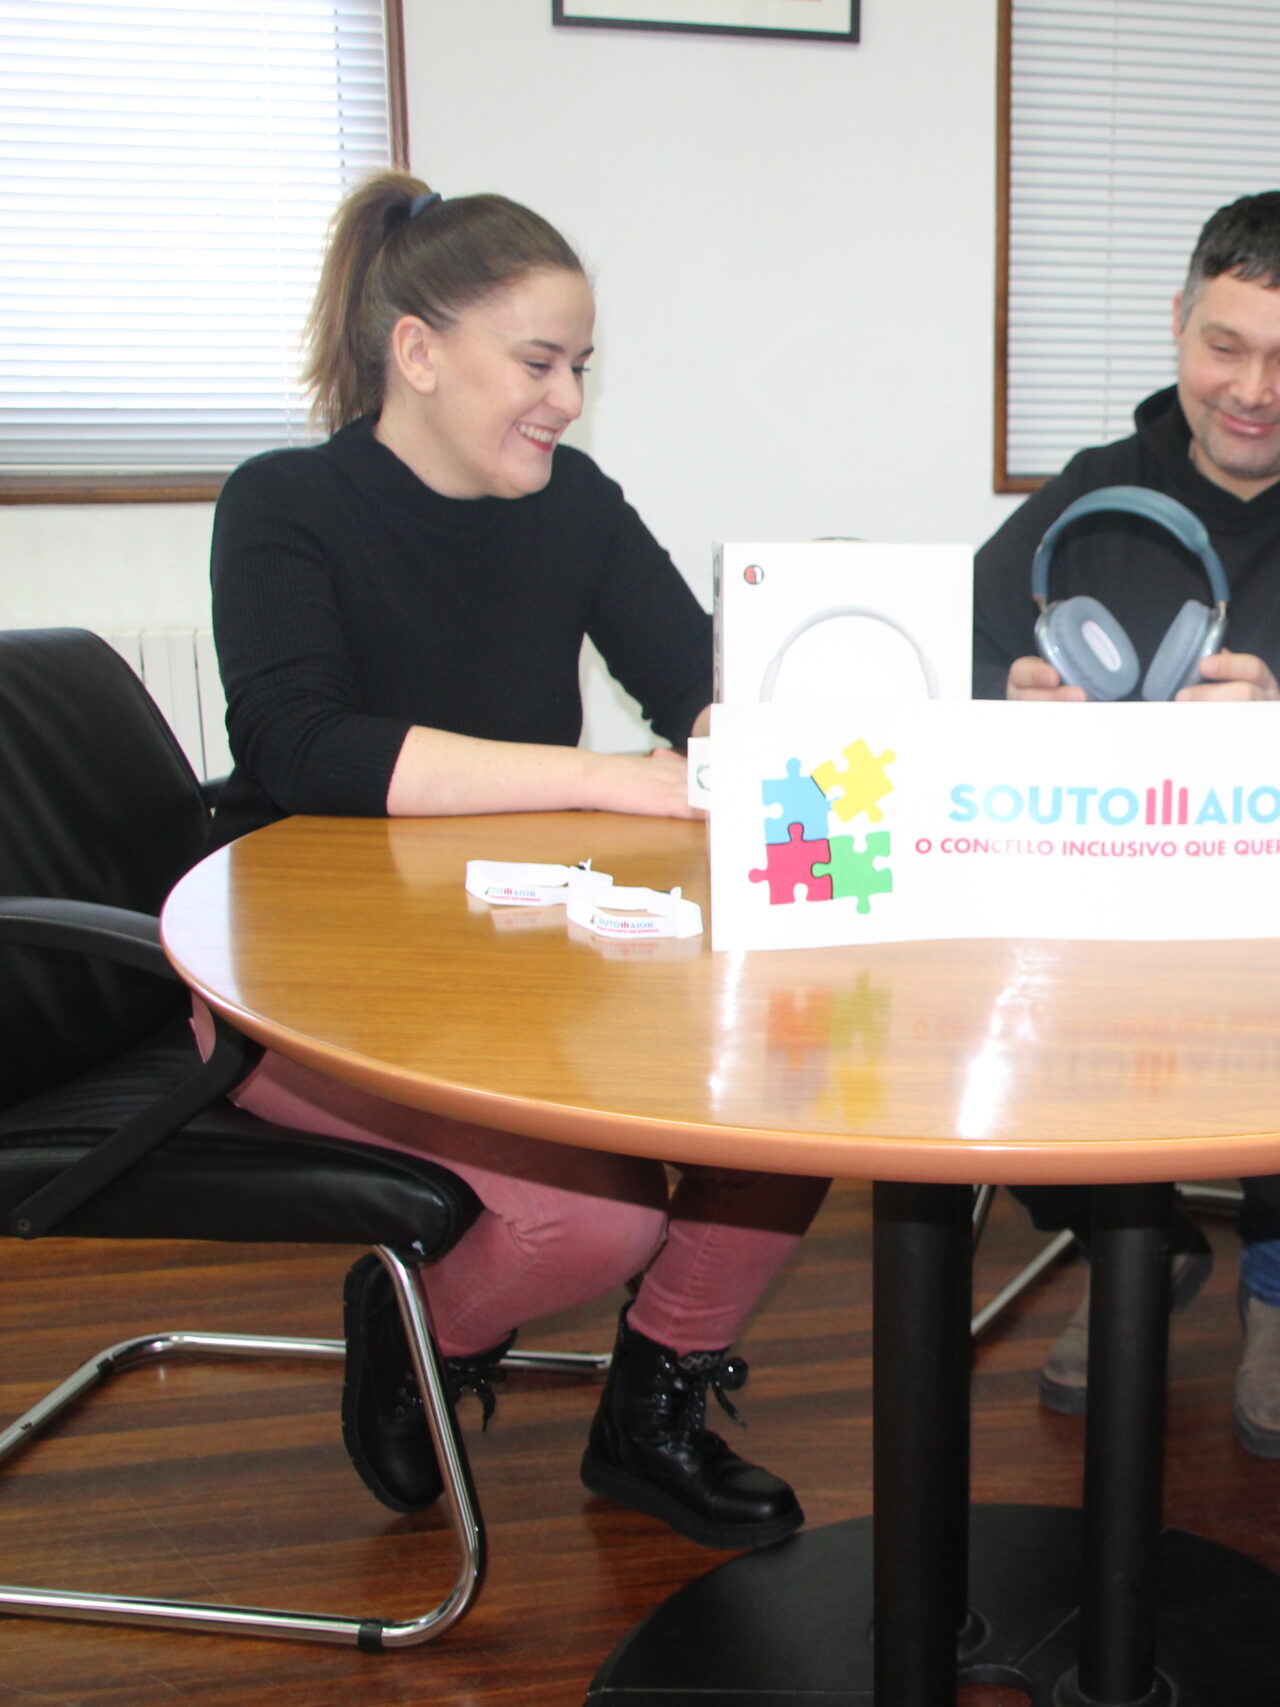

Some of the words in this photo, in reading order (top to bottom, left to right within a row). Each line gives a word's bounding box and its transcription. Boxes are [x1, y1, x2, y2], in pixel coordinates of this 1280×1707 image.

[914, 838, 932, 854] O
[939, 837, 1055, 855] CONCELLO
[1061, 839, 1178, 857] INCLUSIVO
[1184, 839, 1227, 857] QUE
